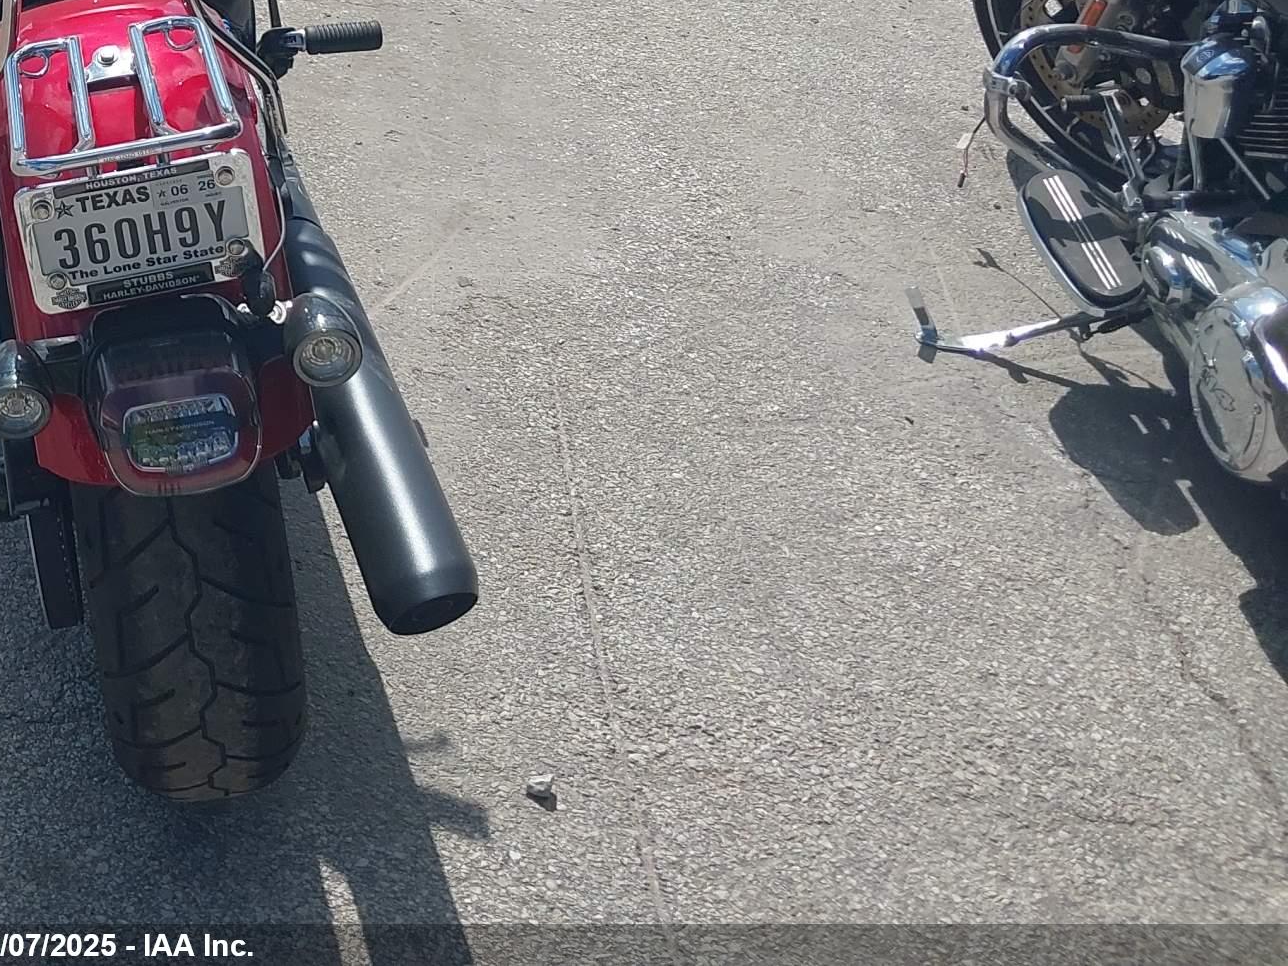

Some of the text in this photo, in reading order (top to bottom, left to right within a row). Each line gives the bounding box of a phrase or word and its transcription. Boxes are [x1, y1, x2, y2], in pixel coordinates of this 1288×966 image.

[85, 173, 142, 191] HOUSTON,
[143, 166, 178, 181] TEXAS
[170, 183, 189, 197] 06
[198, 179, 216, 192] 26
[75, 185, 151, 213] TEXAS
[54, 200, 227, 271] 360H9Y
[68, 245, 225, 281] The Lone Star State
[123, 270, 174, 289] STUBBS
